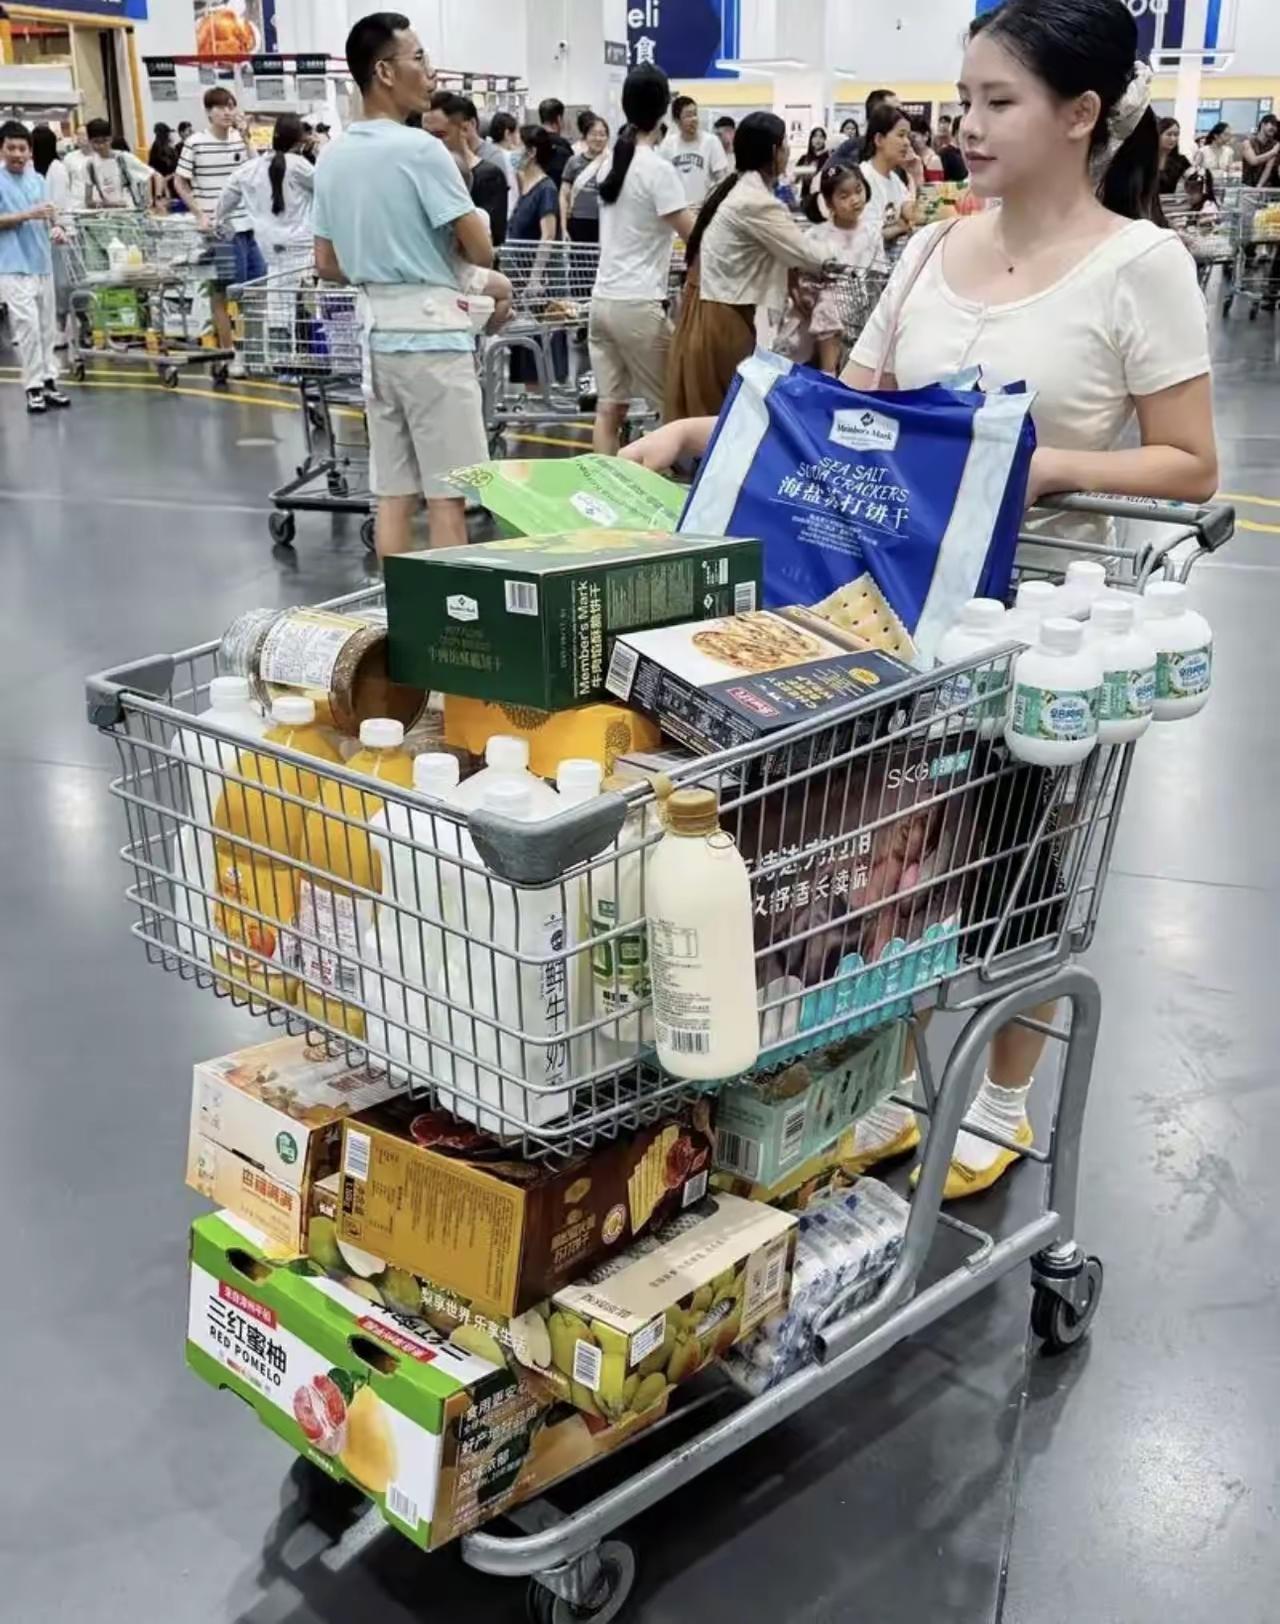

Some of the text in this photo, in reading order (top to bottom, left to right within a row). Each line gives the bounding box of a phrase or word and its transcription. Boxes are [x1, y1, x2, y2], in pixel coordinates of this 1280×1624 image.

[626, 36, 656, 64] 食
[820, 456, 889, 482] SEA SALT
[832, 475, 910, 503] CRACKERS
[577, 580, 591, 696] Member's Mark
[887, 761, 929, 789] SKG
[207, 1294, 287, 1374] 三红蜜柚
[210, 1325, 231, 1349] RED
[235, 1344, 281, 1386] POMELO
